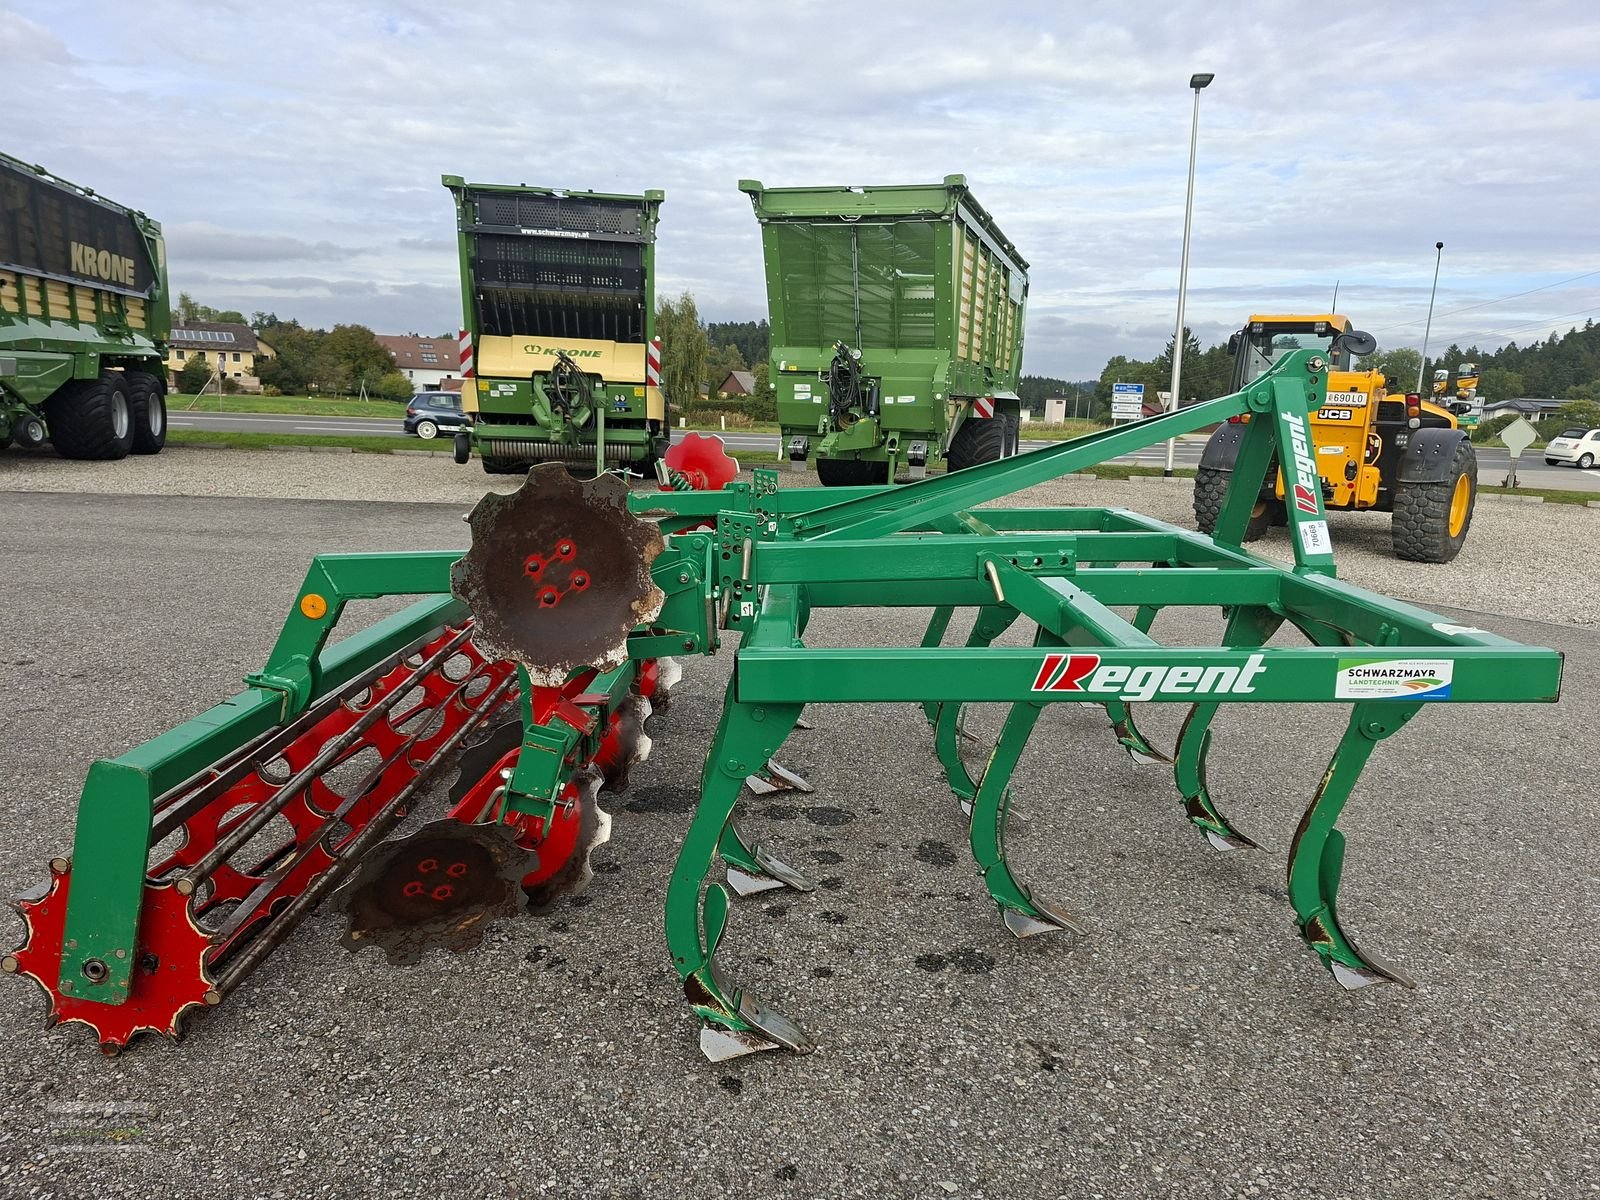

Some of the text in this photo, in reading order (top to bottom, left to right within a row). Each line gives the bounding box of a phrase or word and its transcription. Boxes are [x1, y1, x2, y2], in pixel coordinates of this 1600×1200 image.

[70, 240, 135, 286] KRONE
[1318, 409, 1351, 419] JCB
[1280, 411, 1319, 516] Regent
[1030, 653, 1267, 702] Regent
[1348, 668, 1436, 678] SCHWARZMAYR
